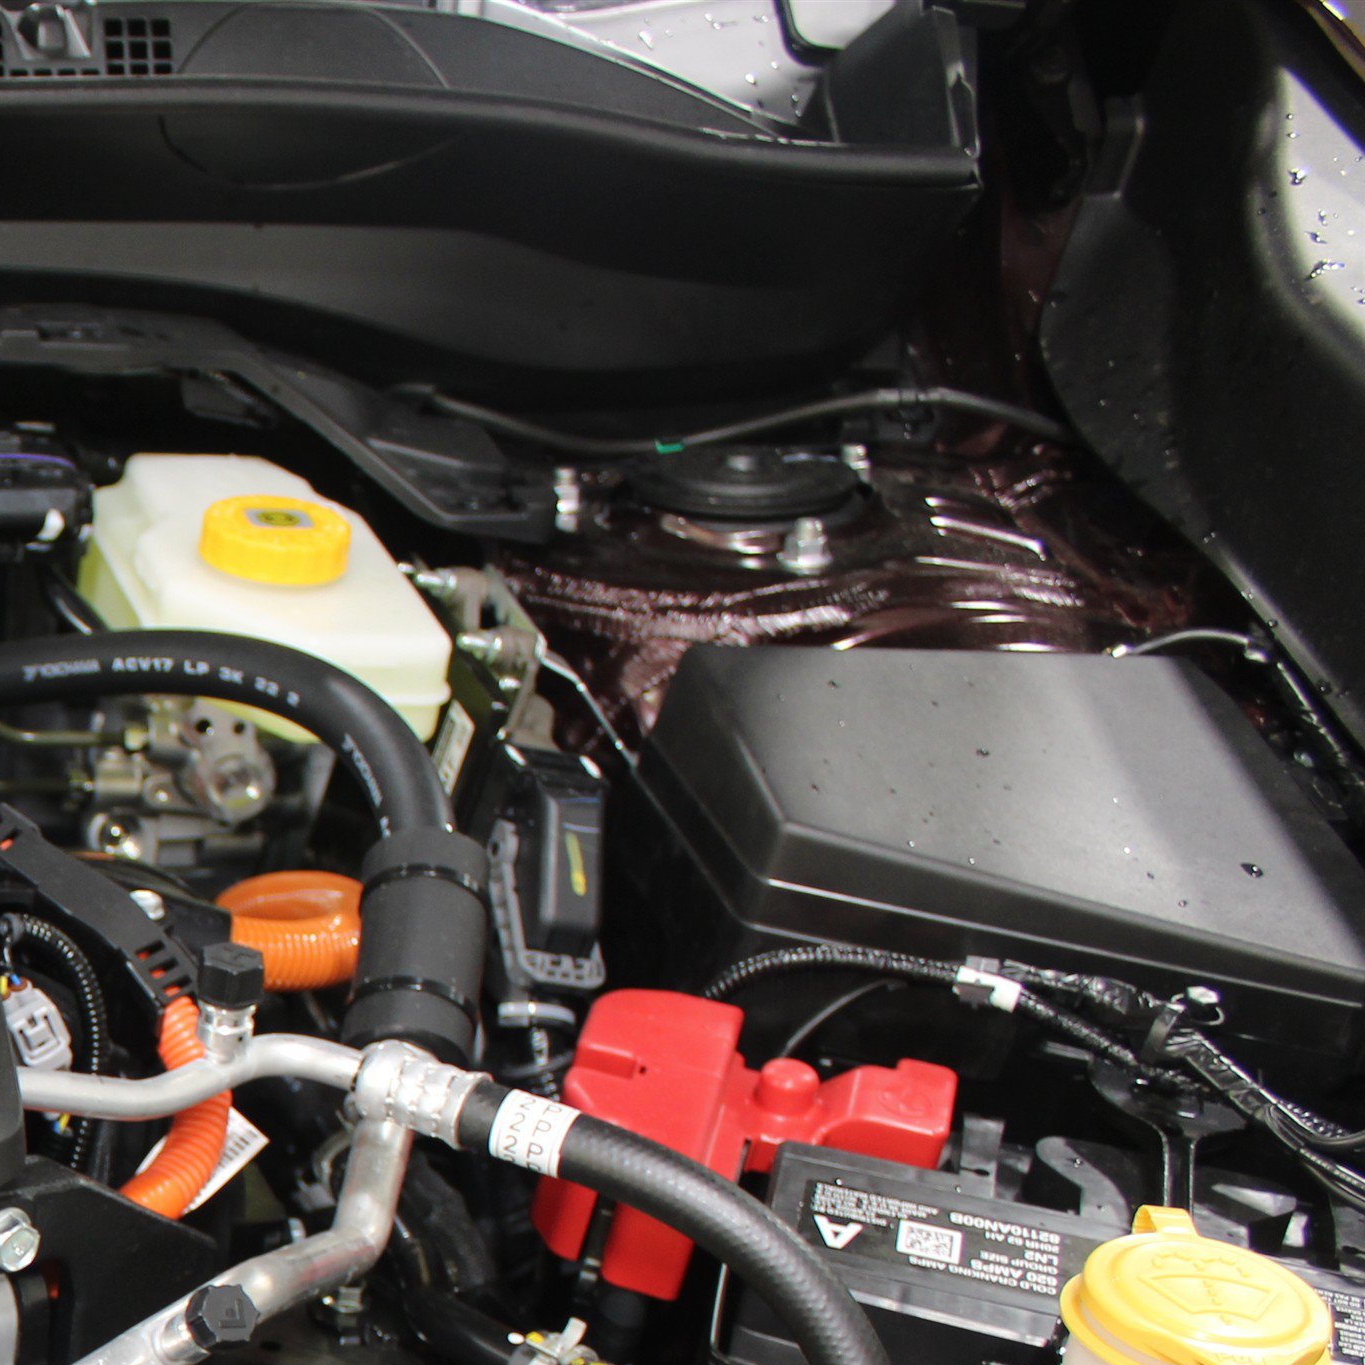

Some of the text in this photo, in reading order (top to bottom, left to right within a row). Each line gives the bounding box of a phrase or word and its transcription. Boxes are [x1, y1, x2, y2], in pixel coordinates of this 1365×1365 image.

[112, 656, 175, 673] ACV17
[510, 1111, 552, 1138] 2 P
[503, 1133, 518, 1155] 2
[526, 1140, 544, 1160] P
[949, 1212, 1061, 1245] 82110AN00B
[970, 1258, 1024, 1280] AMPS
[980, 1251, 1059, 1276] GROUP SIZE
[1023, 1250, 1059, 1266] LN2
[908, 1255, 1057, 1296] COLD CRANKING AMPS
